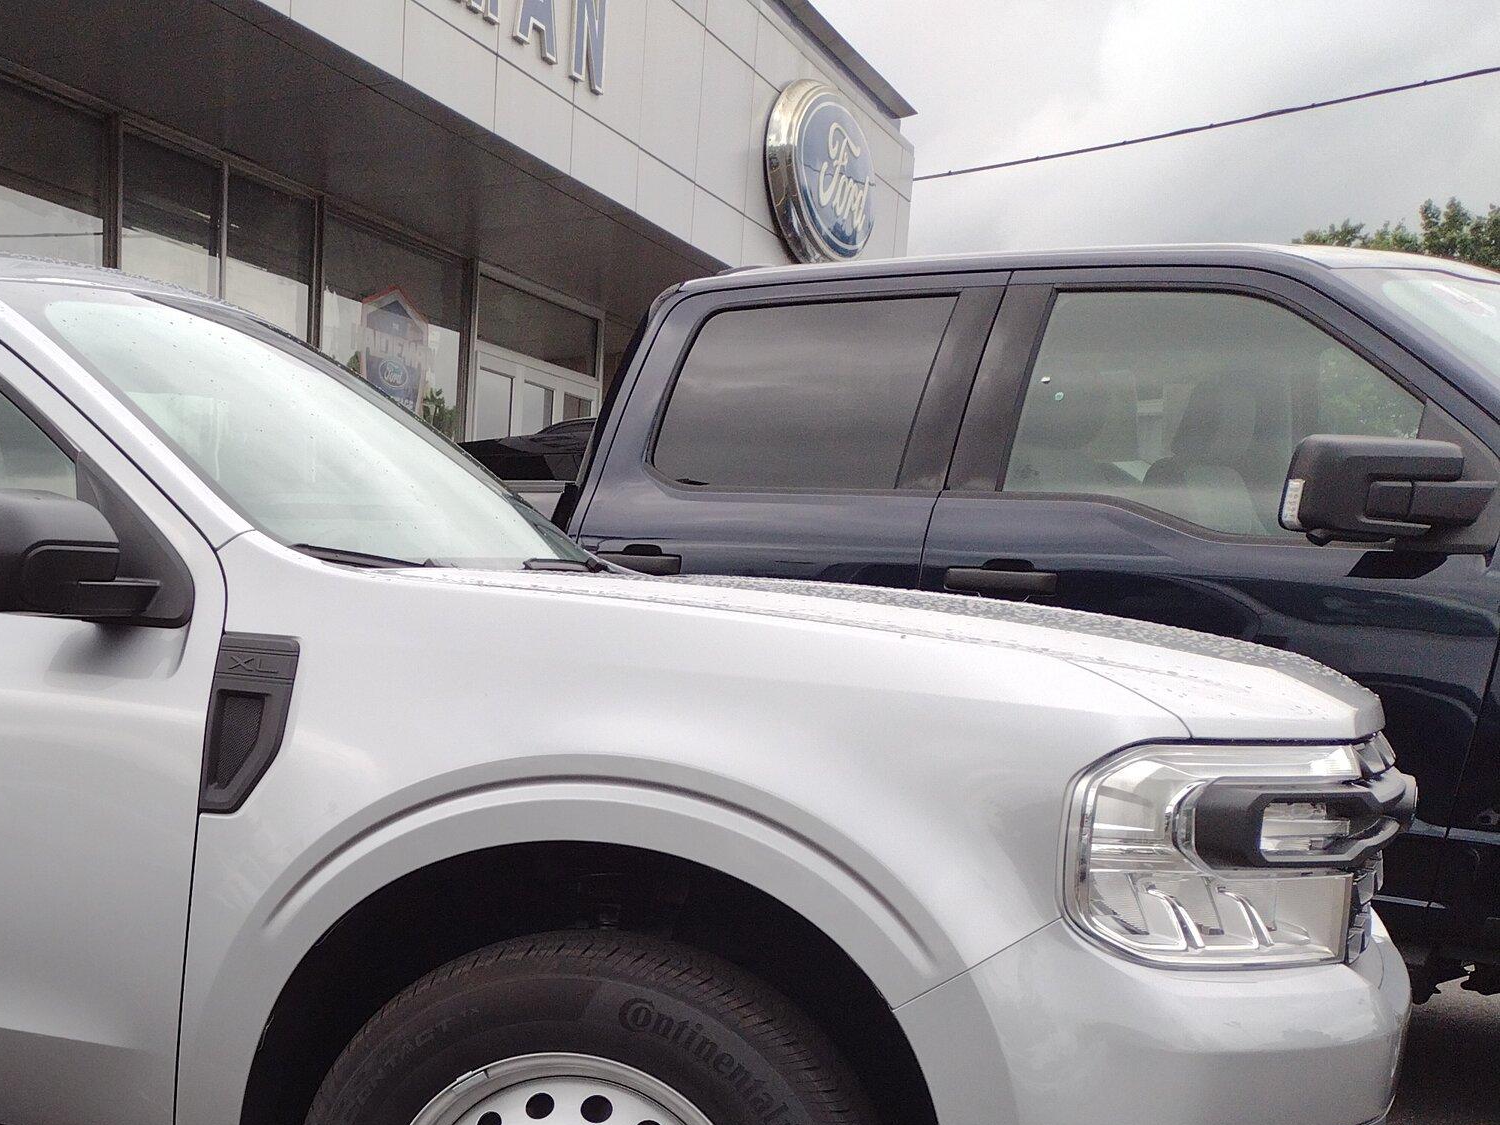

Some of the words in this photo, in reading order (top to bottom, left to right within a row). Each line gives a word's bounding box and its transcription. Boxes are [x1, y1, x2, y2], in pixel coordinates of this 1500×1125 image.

[819, 122, 869, 232] Ford
[228, 656, 279, 674] XL
[618, 997, 789, 1125] Continental
